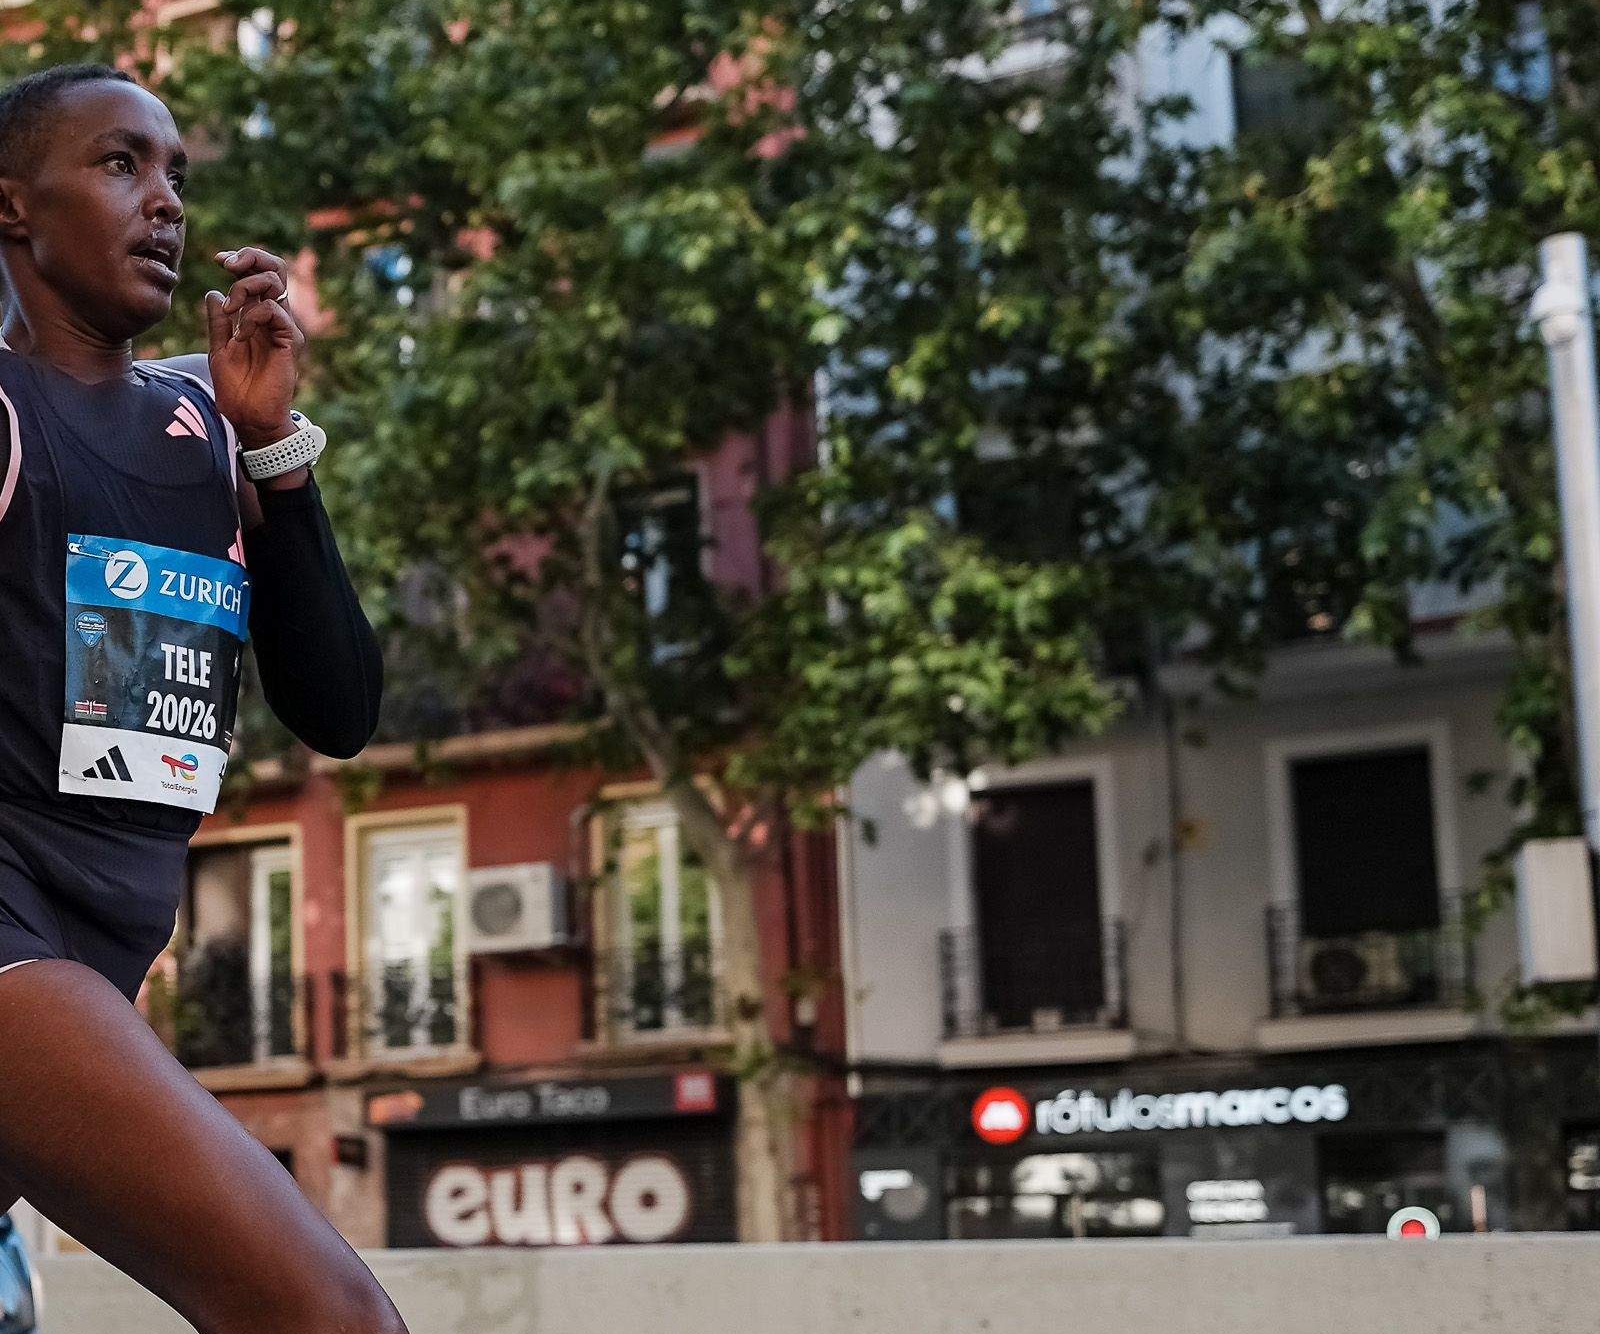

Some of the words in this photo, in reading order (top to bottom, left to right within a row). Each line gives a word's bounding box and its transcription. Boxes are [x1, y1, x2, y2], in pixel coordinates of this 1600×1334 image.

[109, 559, 143, 592] Z
[159, 569, 242, 615] ZURICH
[160, 642, 212, 689] TELE
[145, 690, 217, 740] 20026
